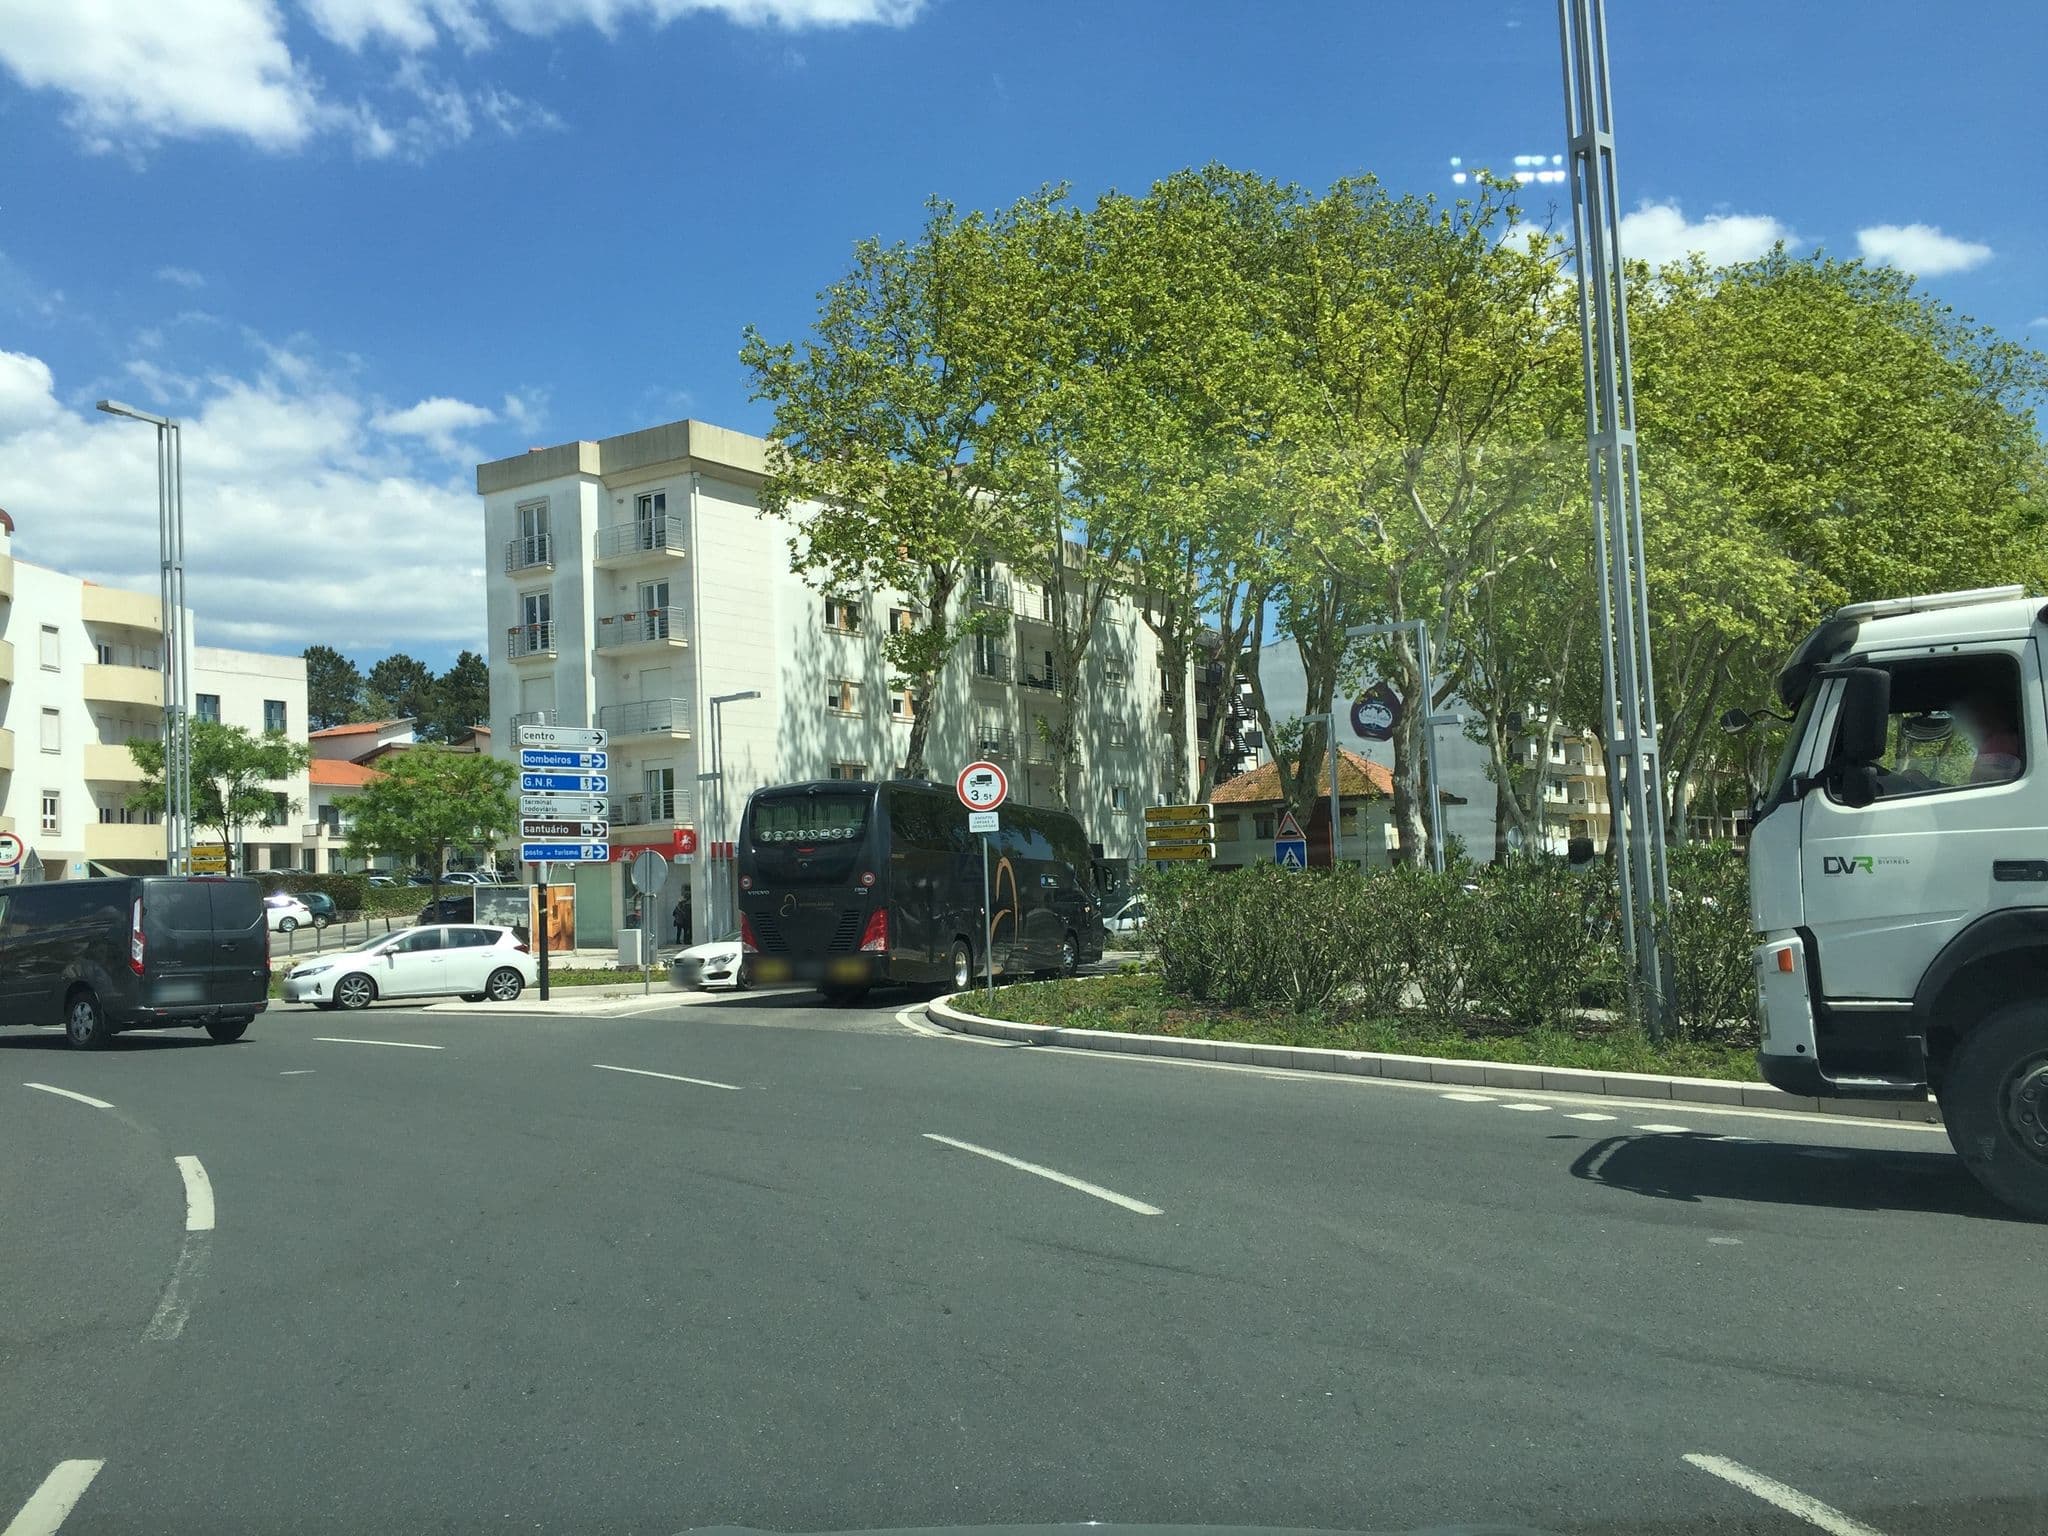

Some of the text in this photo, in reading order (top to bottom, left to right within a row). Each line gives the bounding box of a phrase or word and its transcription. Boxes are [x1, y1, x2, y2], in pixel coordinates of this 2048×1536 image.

[524, 732, 555, 741] centro
[524, 755, 571, 764] bombeiros
[524, 778, 555, 787] G.N.R.
[971, 790, 992, 801] 3.5t
[524, 824, 569, 834] santuário
[1823, 857, 1874, 874] DVR
